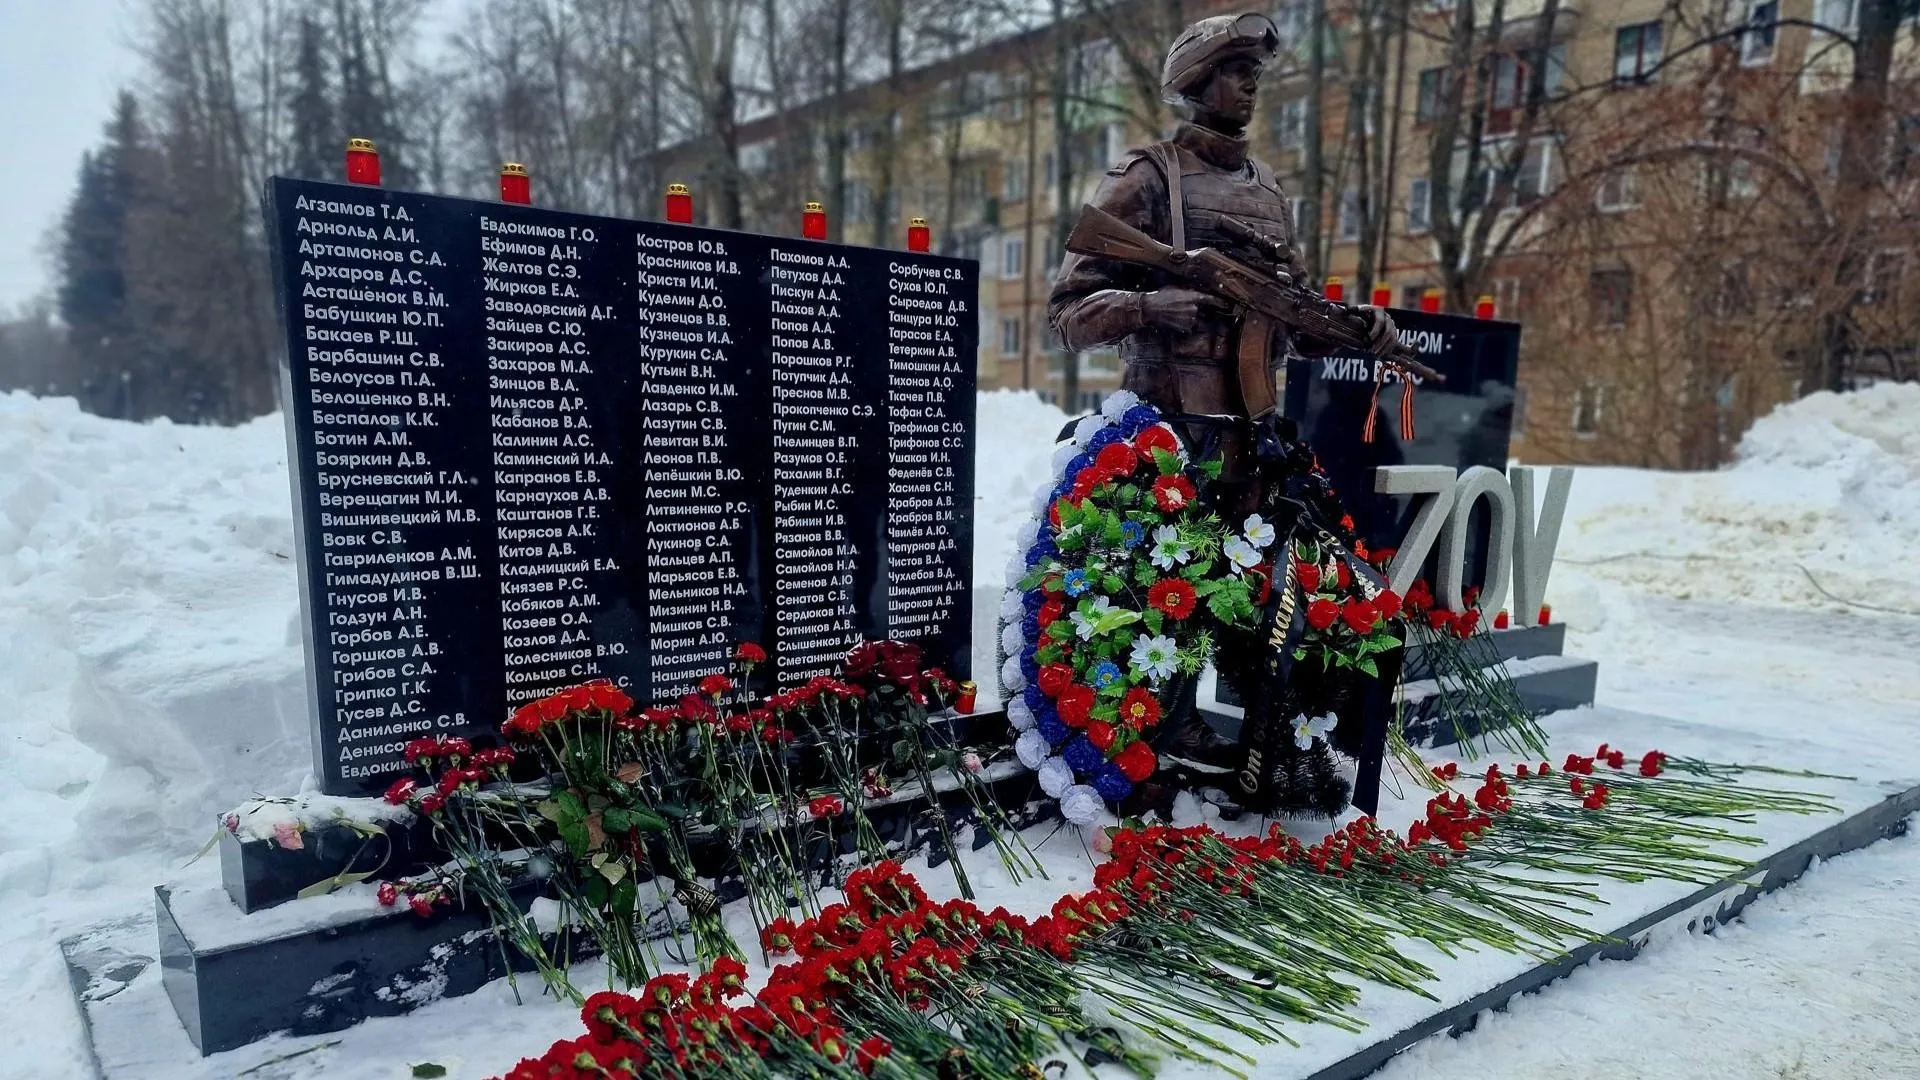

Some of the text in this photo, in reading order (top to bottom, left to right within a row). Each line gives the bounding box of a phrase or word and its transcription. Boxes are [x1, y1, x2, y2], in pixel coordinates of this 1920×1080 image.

[296, 195, 413, 221] Агзамов Т.А.
[298, 217, 419, 243] Арнольд А.И.
[481, 216, 598, 242] Евдокимов Г.О.
[299, 239, 446, 266] Артамонов С.А.
[482, 237, 581, 260] Ефимов Д.Н.
[637, 233, 727, 255] Костров Ю.В.
[638, 252, 740, 275] Красников И.В.
[771, 249, 850, 268] Пахомов А.А.
[483, 257, 581, 279] Желтов С.Э.
[771, 266, 845, 285] Петухов Д.А.
[889, 262, 963, 280] Сорбучев С.В.
[413, 291, 449, 307] В.М.
[639, 289, 726, 309] Куделин Д.О.
[771, 283, 840, 301] Пискун А.А.
[485, 297, 616, 320] Заводовский Д.Г.
[889, 295, 967, 313] Сыроедов Д.В.
[304, 304, 444, 327] Бабушкин Ю.П.
[640, 308, 730, 326] Кузнецов В.В.
[889, 311, 958, 327] Танцура И.Ю.
[486, 317, 585, 336] Зайцев С.Ю.
[640, 326, 733, 344] Кузнецов И.А.
[772, 318, 835, 334] Попов А.А.
[308, 347, 444, 367] Барбашин С.В.
[772, 352, 854, 367] Порошков Р.Г.
[889, 343, 957, 358] Тетеркин А.В.
[489, 356, 593, 374] Захаров М.А.
[641, 363, 715, 378] Кутьин В.Н.
[889, 359, 963, 373] Тимошкин А.А.
[1320, 357, 1368, 382] ЖИТЬ
[310, 368, 435, 387] Белоусов П.А.
[773, 386, 850, 400] Преснов М.В.
[491, 395, 587, 411] Ильясов Д.Р.
[642, 399, 722, 415] Лазарь С.В.
[773, 403, 875, 417] Прокопченко С.Э.
[313, 410, 438, 426] Беспалов К.К.
[888, 406, 946, 419] Тофан С.А.
[493, 433, 594, 446] Калинин А.С.
[644, 434, 727, 447] Левитан В.И.
[774, 436, 858, 448] Пчелинцев В.П.
[888, 437, 963, 450] Трифонов С.С.
[317, 452, 430, 469] Бояркин Д.В.
[494, 452, 613, 465] Каминский И.А.
[774, 452, 847, 466] Разумов О.Е.
[318, 471, 467, 489] Брусневский Г.Л.
[645, 469, 744, 481] Лепёшкин В.Ю.
[320, 490, 462, 509] Верещагин М.И.
[496, 488, 611, 505] Карнаухов А.В.
[645, 486, 720, 498] Лесин М.С.
[775, 483, 854, 498] Руденкин А.С.
[646, 502, 750, 516] Литвиненко Р.С.
[888, 496, 954, 510] Храбров А.В.
[322, 509, 480, 526] Вишнивецкий М.В.
[498, 524, 596, 542] Кирясов А.К.
[775, 530, 845, 543] Рязанов В.В.
[926, 525, 949, 536] А.Ю.
[325, 546, 476, 568] Гавриленков А.М.
[648, 551, 734, 566] Мальцев А.П.
[888, 554, 944, 567] Чистов В.А.
[327, 565, 481, 586] Гимадудинов В.Ш.
[500, 558, 619, 576] Кладницкий Е.А.
[649, 567, 739, 585] Марьясов Е.В.
[501, 577, 587, 594] Князев Р.С.
[502, 594, 600, 612] Кобяков А.М.
[776, 590, 849, 606] Сенатов С.Б.
[329, 606, 427, 626] Годзун А.Н.
[650, 600, 735, 617] Мизинин Н.В.
[650, 616, 731, 633] Мишков С.В.
[504, 630, 590, 648] Козлов Д.А.
[333, 642, 443, 666] Горшков А.В.
[505, 643, 628, 666] Колесников В.Ю.
[336, 680, 430, 705] Грипко Г.К.
[338, 713, 469, 743] Даниленко С.В.
